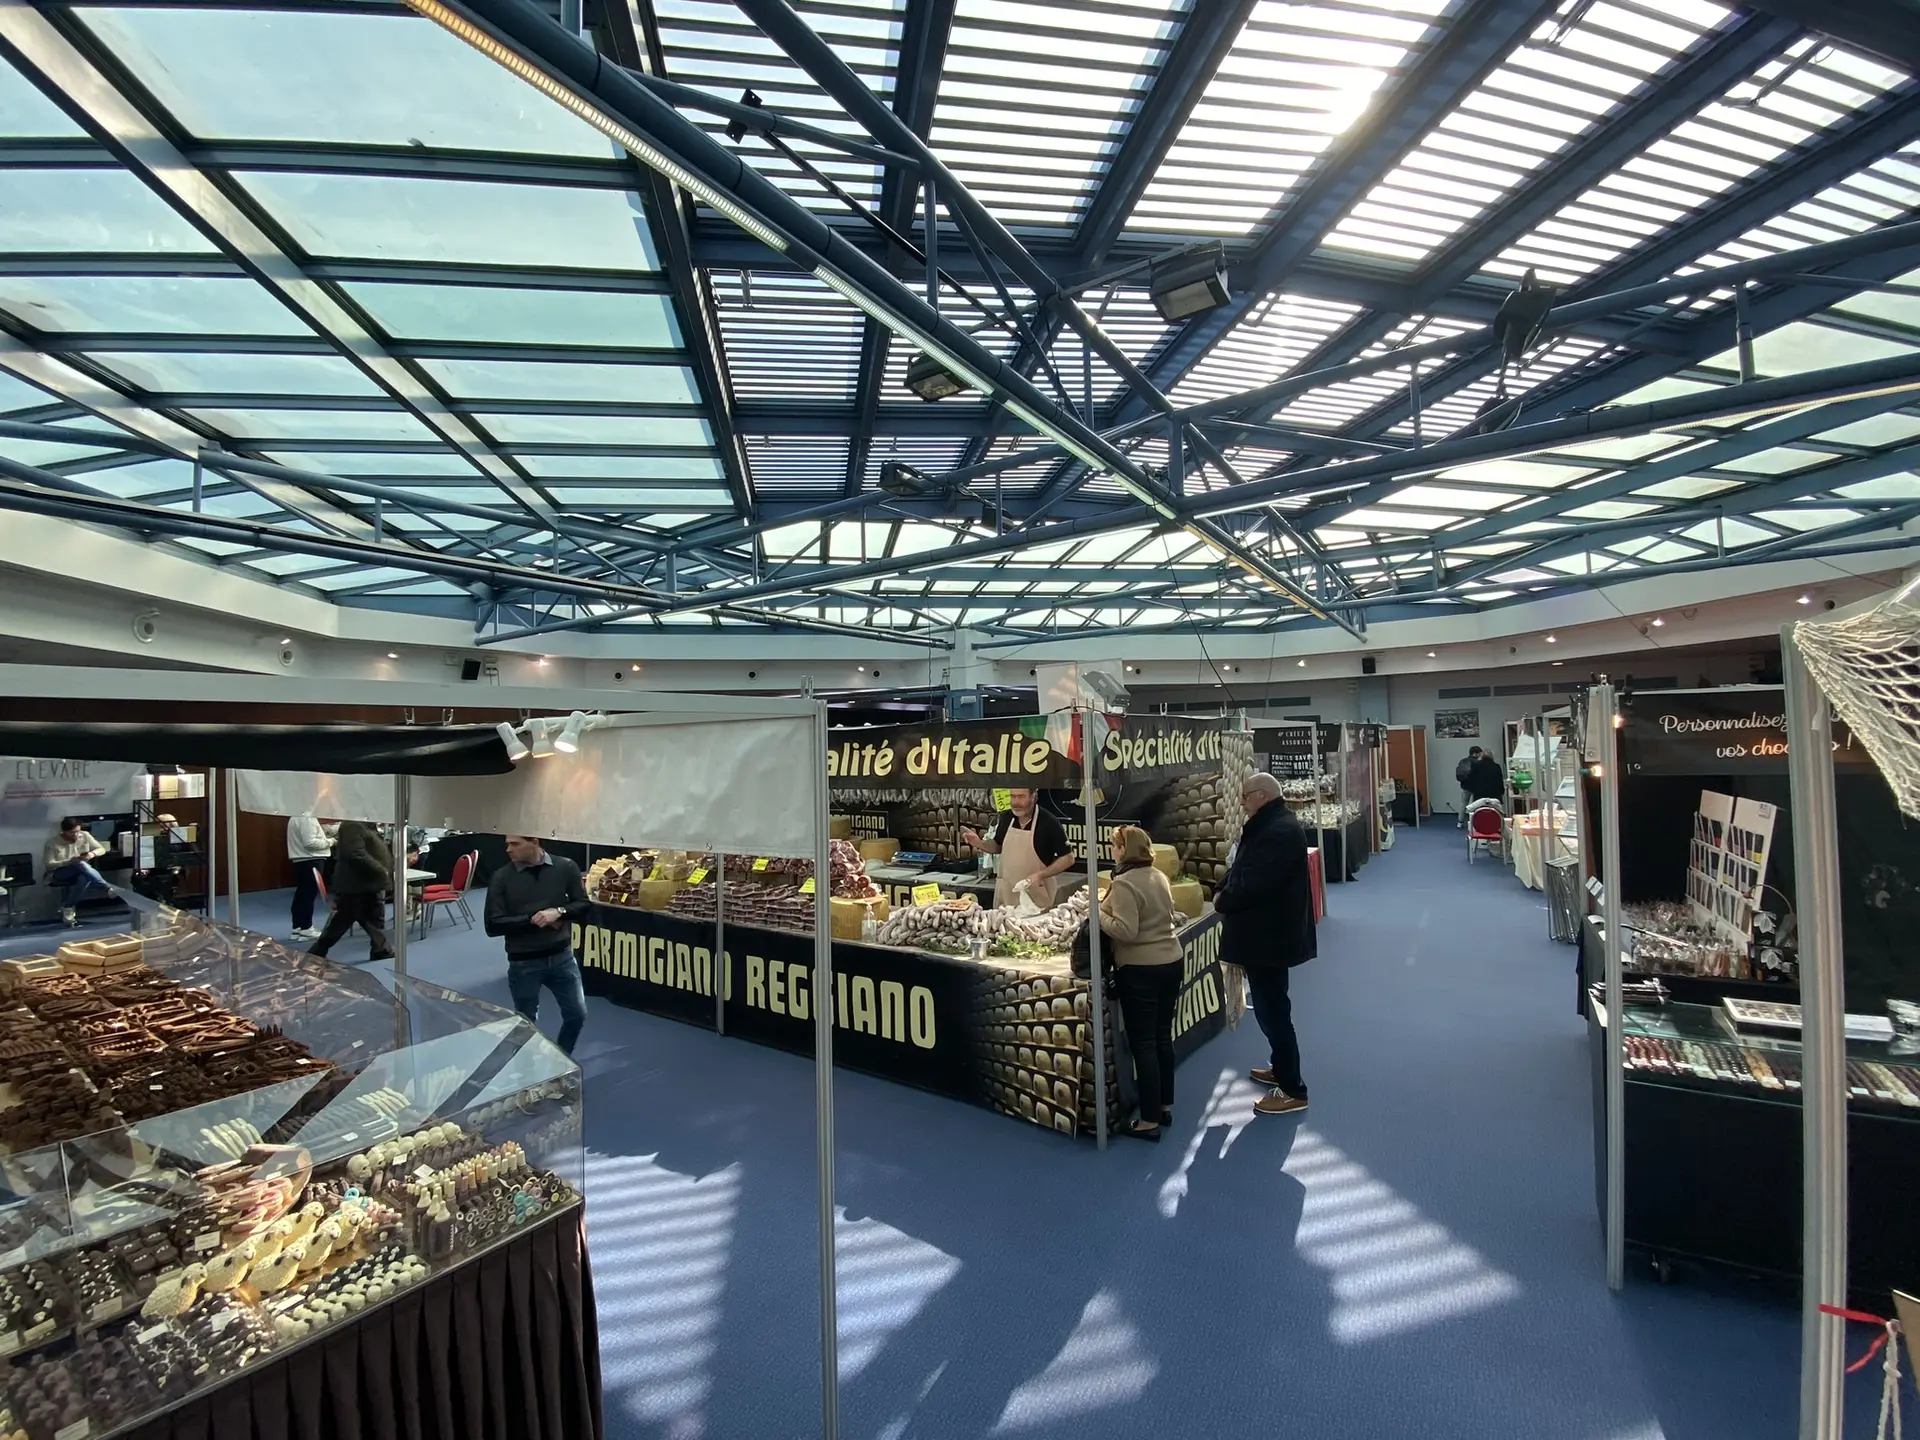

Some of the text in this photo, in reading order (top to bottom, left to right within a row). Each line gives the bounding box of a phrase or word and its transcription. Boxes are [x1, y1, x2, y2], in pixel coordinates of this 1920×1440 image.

[906, 733, 1051, 775] d'Italie
[1103, 730, 1193, 771] Spécialité
[1716, 743, 1748, 758] vos
[570, 922, 936, 1049] PARMIGIANO REGIANO
